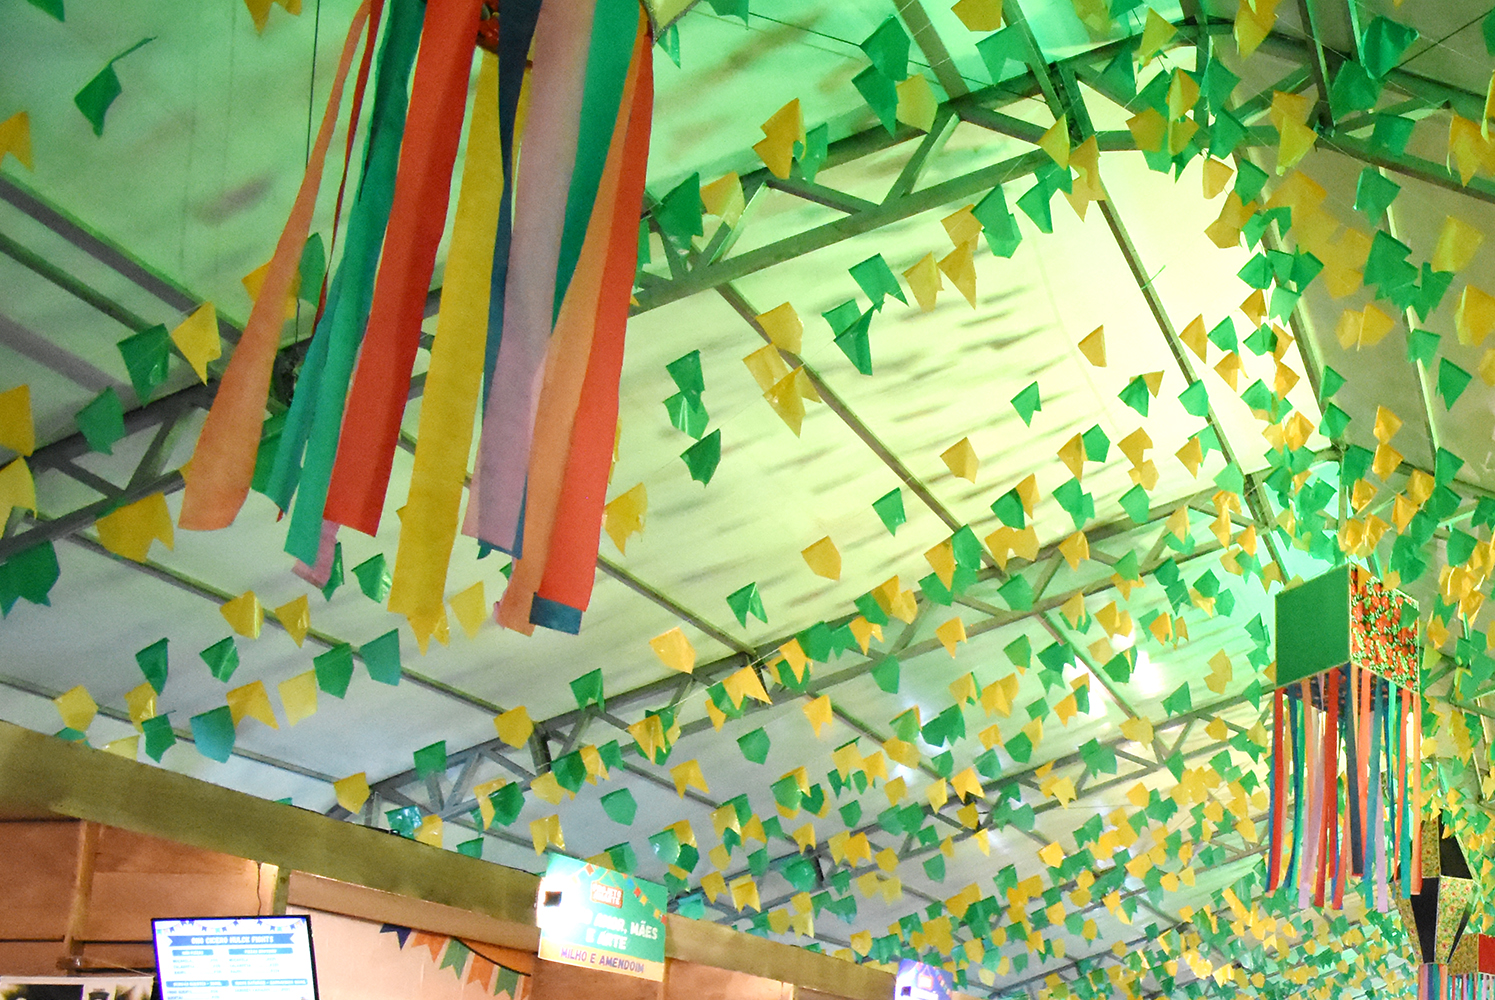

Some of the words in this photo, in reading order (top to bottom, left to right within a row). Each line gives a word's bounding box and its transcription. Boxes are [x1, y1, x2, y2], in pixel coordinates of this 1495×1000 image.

[630, 920, 658, 940] MÃES
[205, 936, 228, 945] CICERO
[560, 947, 587, 961] MILHO
[589, 953, 596, 964] E
[599, 955, 645, 973] AMENDOIM
